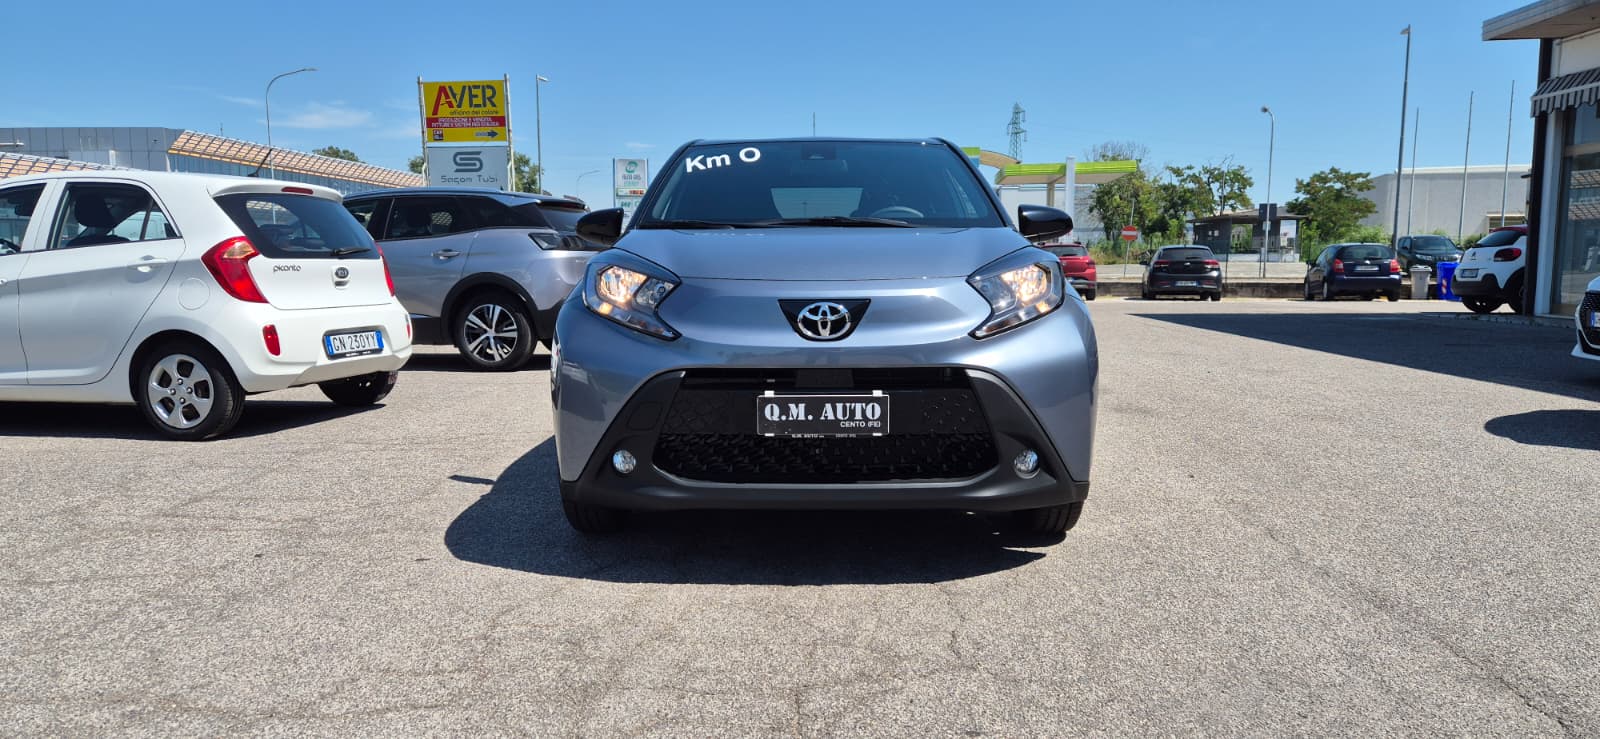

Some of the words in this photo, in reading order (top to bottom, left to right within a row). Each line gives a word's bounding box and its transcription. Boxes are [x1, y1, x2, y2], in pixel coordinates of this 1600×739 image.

[432, 84, 497, 115] AVER
[685, 154, 731, 173] Km
[476, 174, 498, 183] Tubi
[764, 403, 813, 421] Q.M.
[820, 402, 881, 420] AUTO
